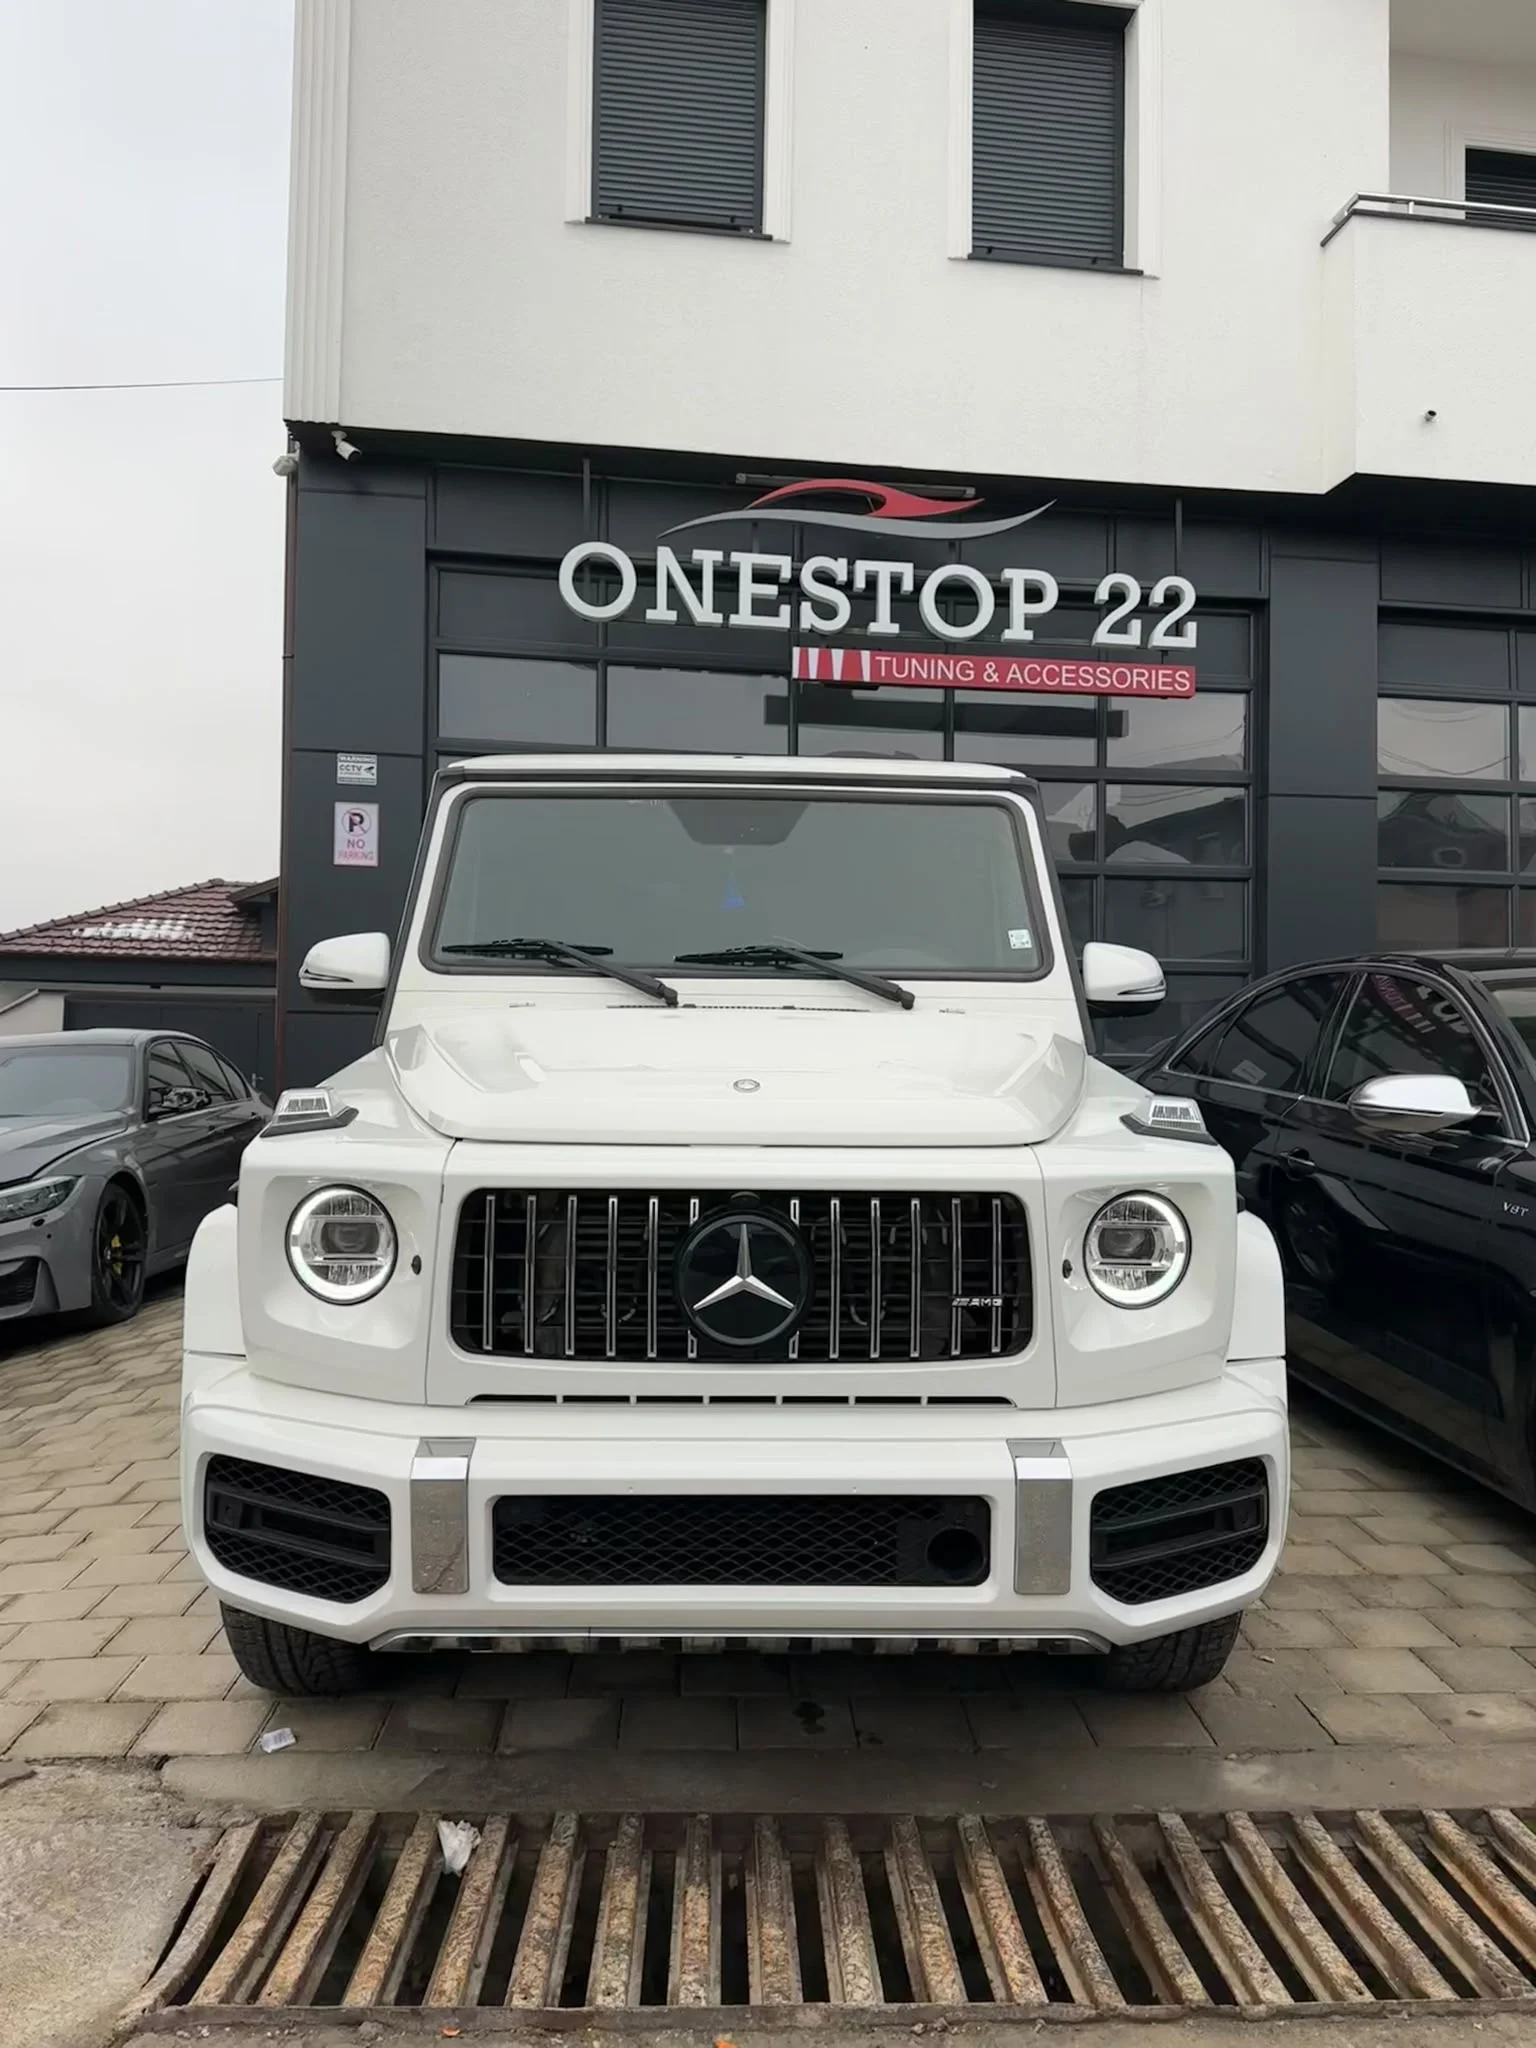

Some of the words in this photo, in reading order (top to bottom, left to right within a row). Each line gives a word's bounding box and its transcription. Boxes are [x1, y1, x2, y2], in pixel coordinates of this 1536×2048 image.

[558, 541, 1059, 641] ONESTOP
[1093, 573, 1198, 650] 22
[876, 656, 975, 681] TUNING
[983, 662, 999, 683] &
[1006, 664, 1191, 692] ACCESSORIES
[339, 764, 362, 772] CCTV
[347, 839, 366, 849] NO
